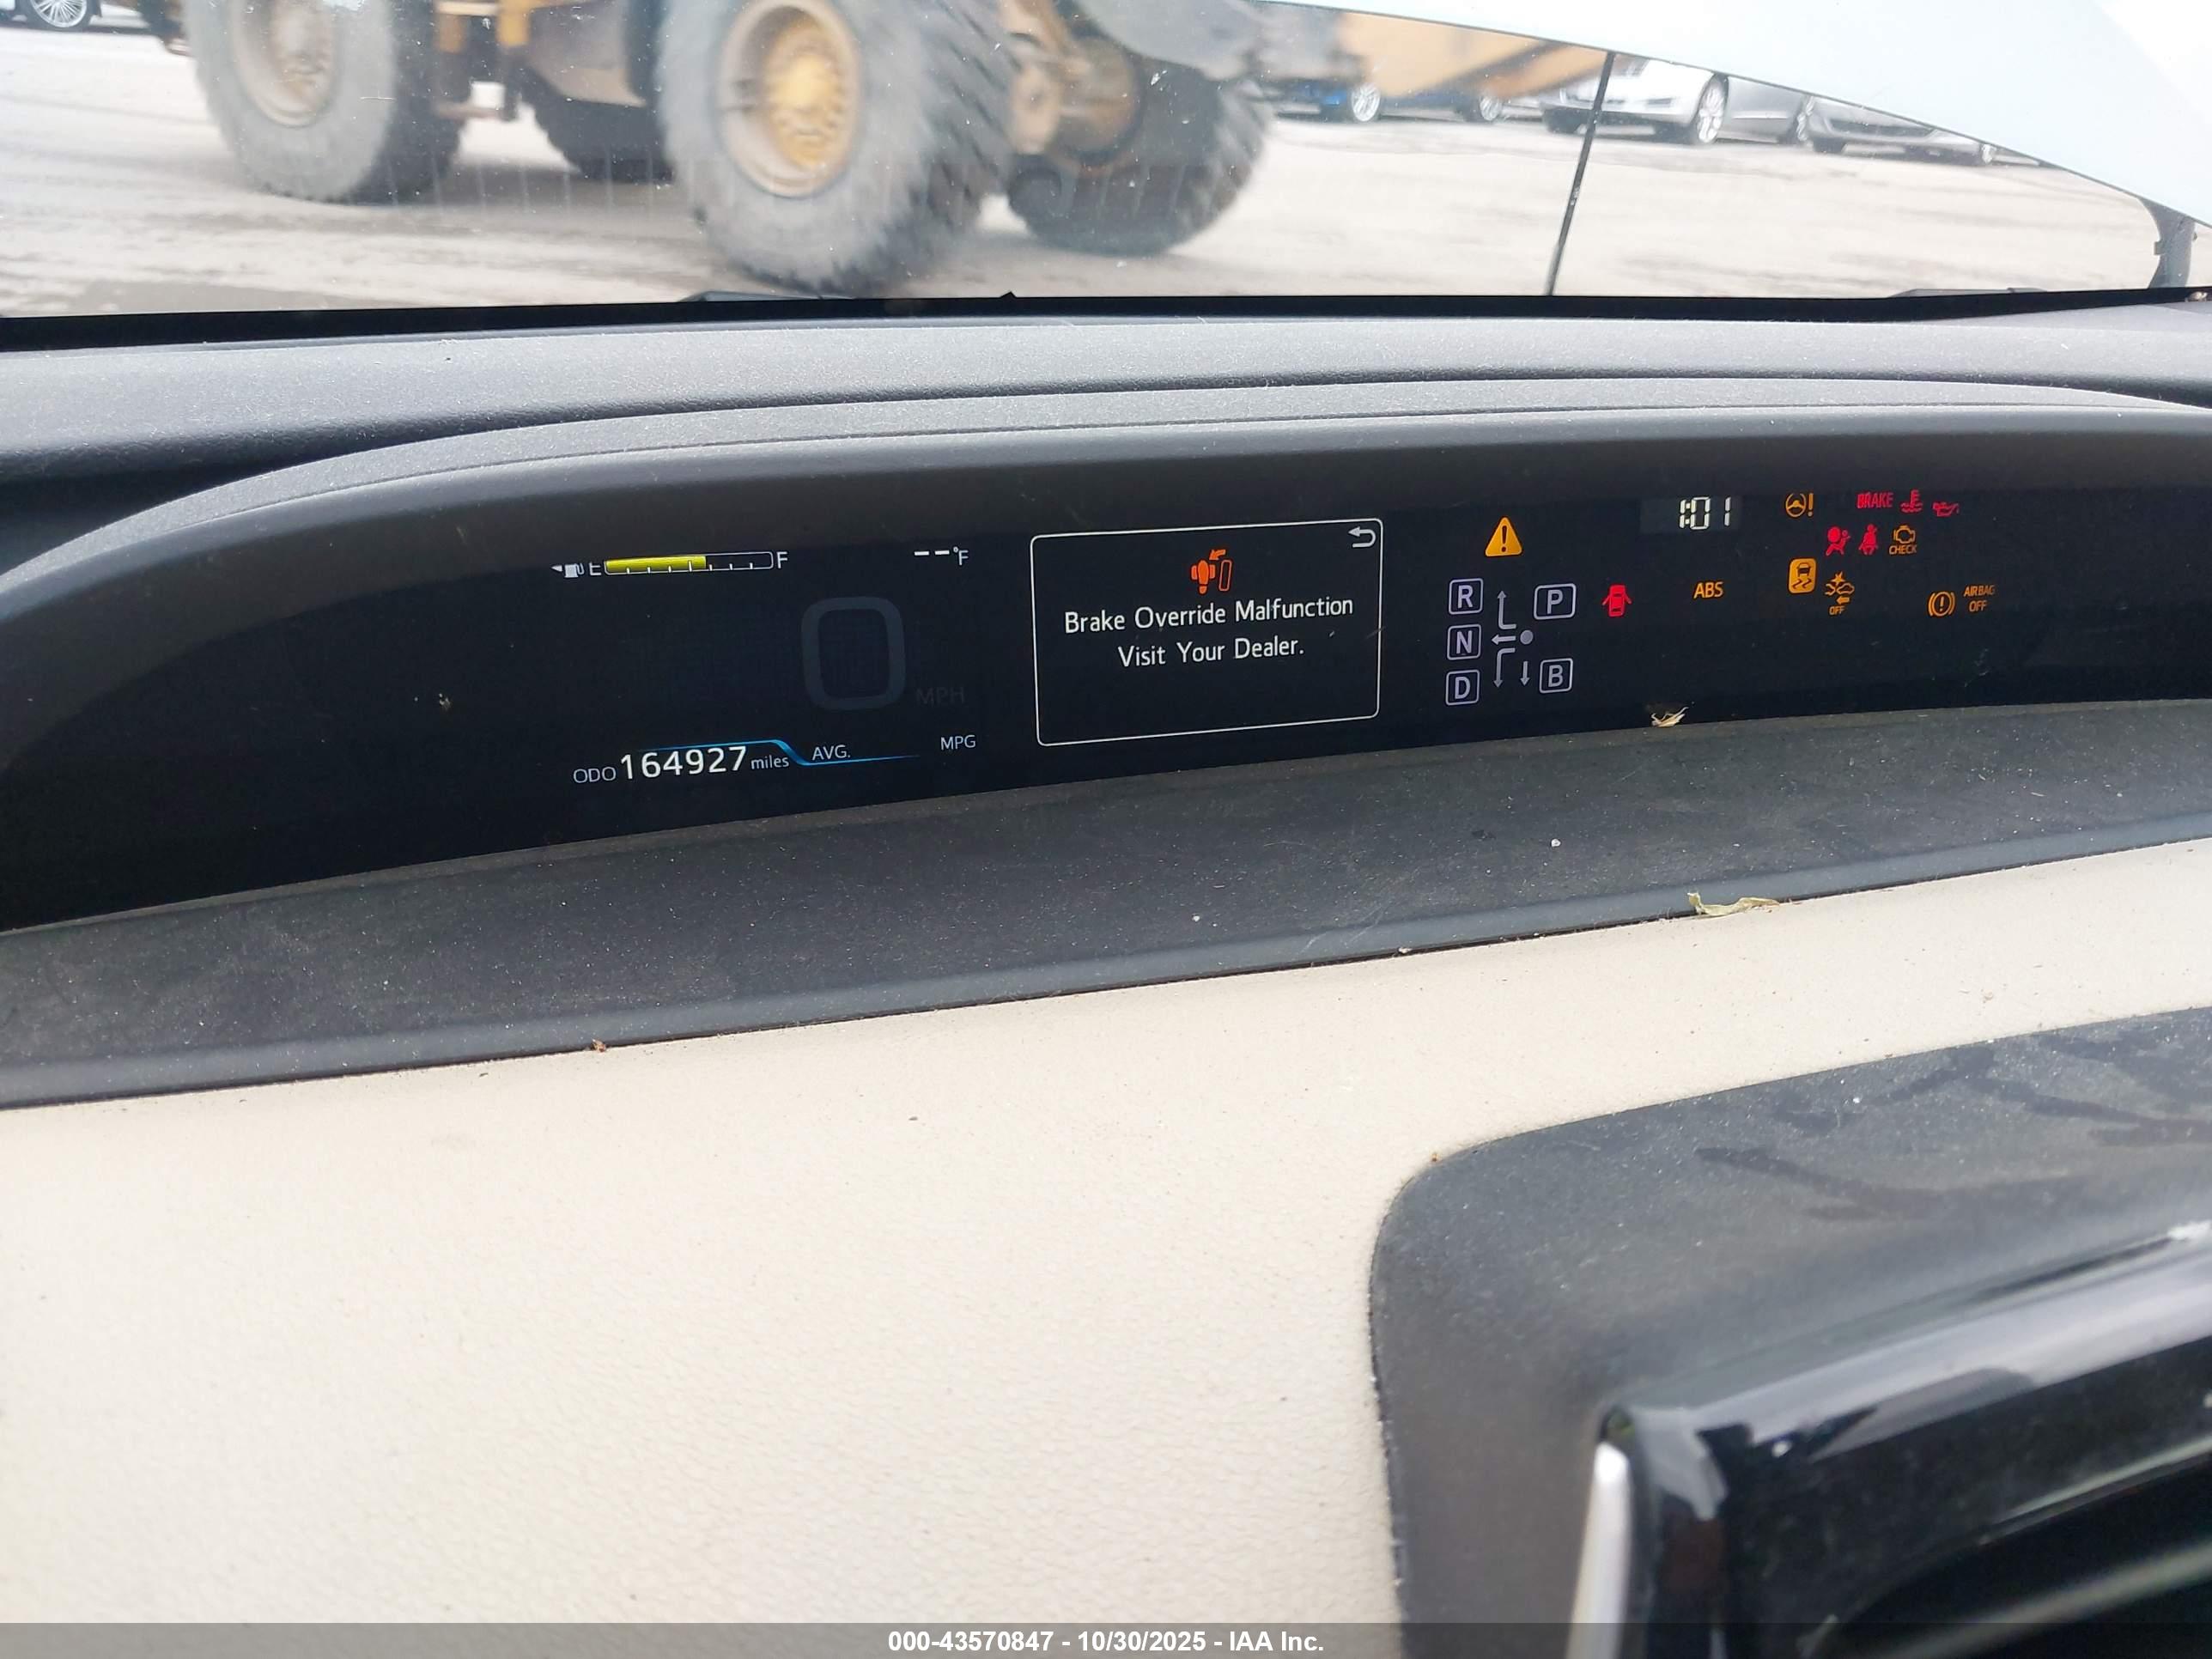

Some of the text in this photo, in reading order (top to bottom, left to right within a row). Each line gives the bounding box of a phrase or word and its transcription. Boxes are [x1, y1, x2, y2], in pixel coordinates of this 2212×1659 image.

[1857, 492, 1893, 509] BRAKE
[1679, 496, 1732, 531] 1:01
[1889, 544, 1917, 556] CHECK
[776, 551, 789, 569] F
[1456, 585, 1474, 609] R
[1693, 581, 1724, 599] ABS
[1964, 585, 1996, 598] AIRBAG
[1547, 589, 1564, 615] P
[1828, 605, 1845, 616] OFF
[1968, 600, 1989, 612] OFF
[1064, 596, 1354, 634] Brake Override Malfunction
[1117, 635, 1305, 667] Visit Your Dealer.
[1455, 630, 1474, 654] N
[1548, 665, 1564, 688] B
[915, 688, 966, 706] MPH
[1454, 676, 1471, 700] D
[939, 734, 977, 750] MPG
[811, 744, 851, 761] AVG.
[573, 745, 790, 783] ODO 164927 miles
